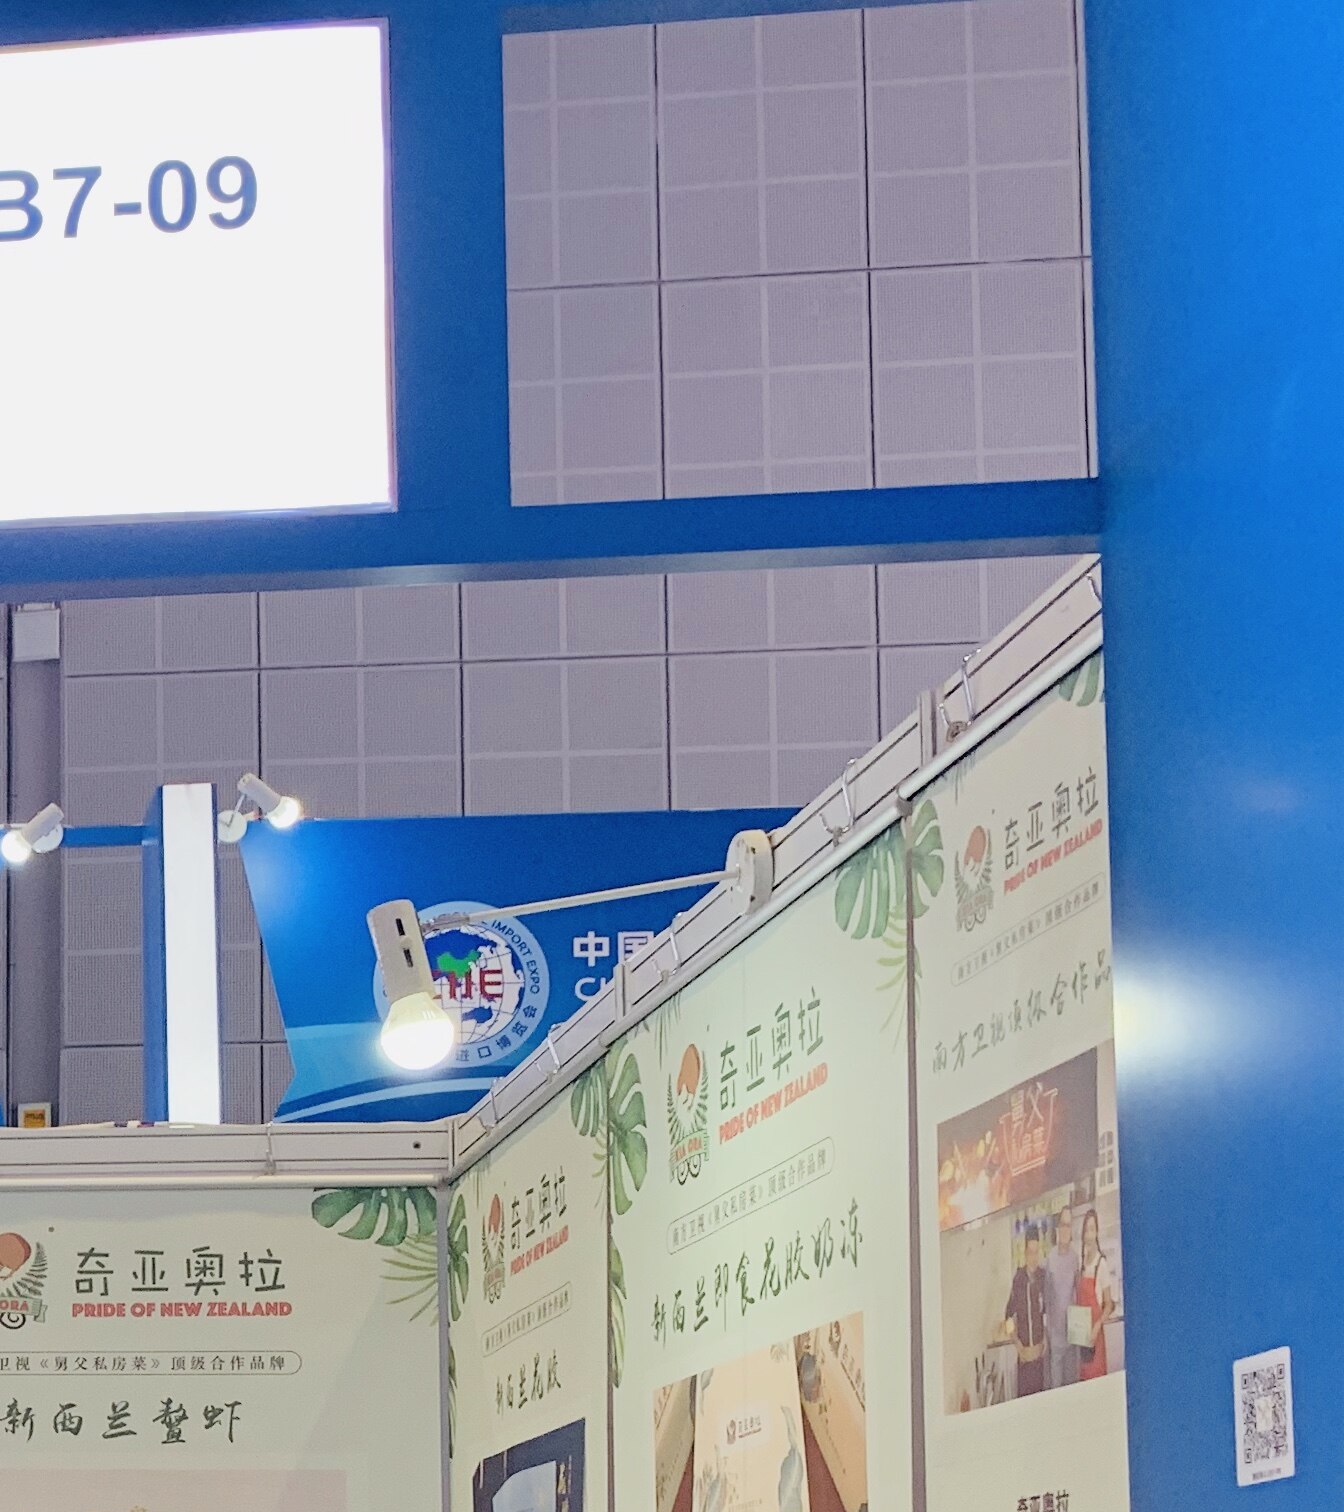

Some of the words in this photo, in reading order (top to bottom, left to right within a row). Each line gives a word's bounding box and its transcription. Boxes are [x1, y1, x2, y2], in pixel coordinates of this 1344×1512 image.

[1004, 765, 1100, 872] 奇亚奥拉
[719, 985, 825, 1112] 奇亚奥拉
[718, 1113, 746, 1146] PRIDE
[745, 1103, 760, 1127] OF
[760, 1091, 783, 1122] NEW
[783, 1061, 829, 1108] ZEALAND
[511, 1165, 568, 1250] 奇亚奥拉
[71, 1302, 127, 1319] PRIDE
[129, 1302, 157, 1318] OF
[159, 1302, 202, 1318] NEW
[205, 1301, 294, 1318] ZEALAND
[74, 1244, 288, 1298] 奇亚奥拉
